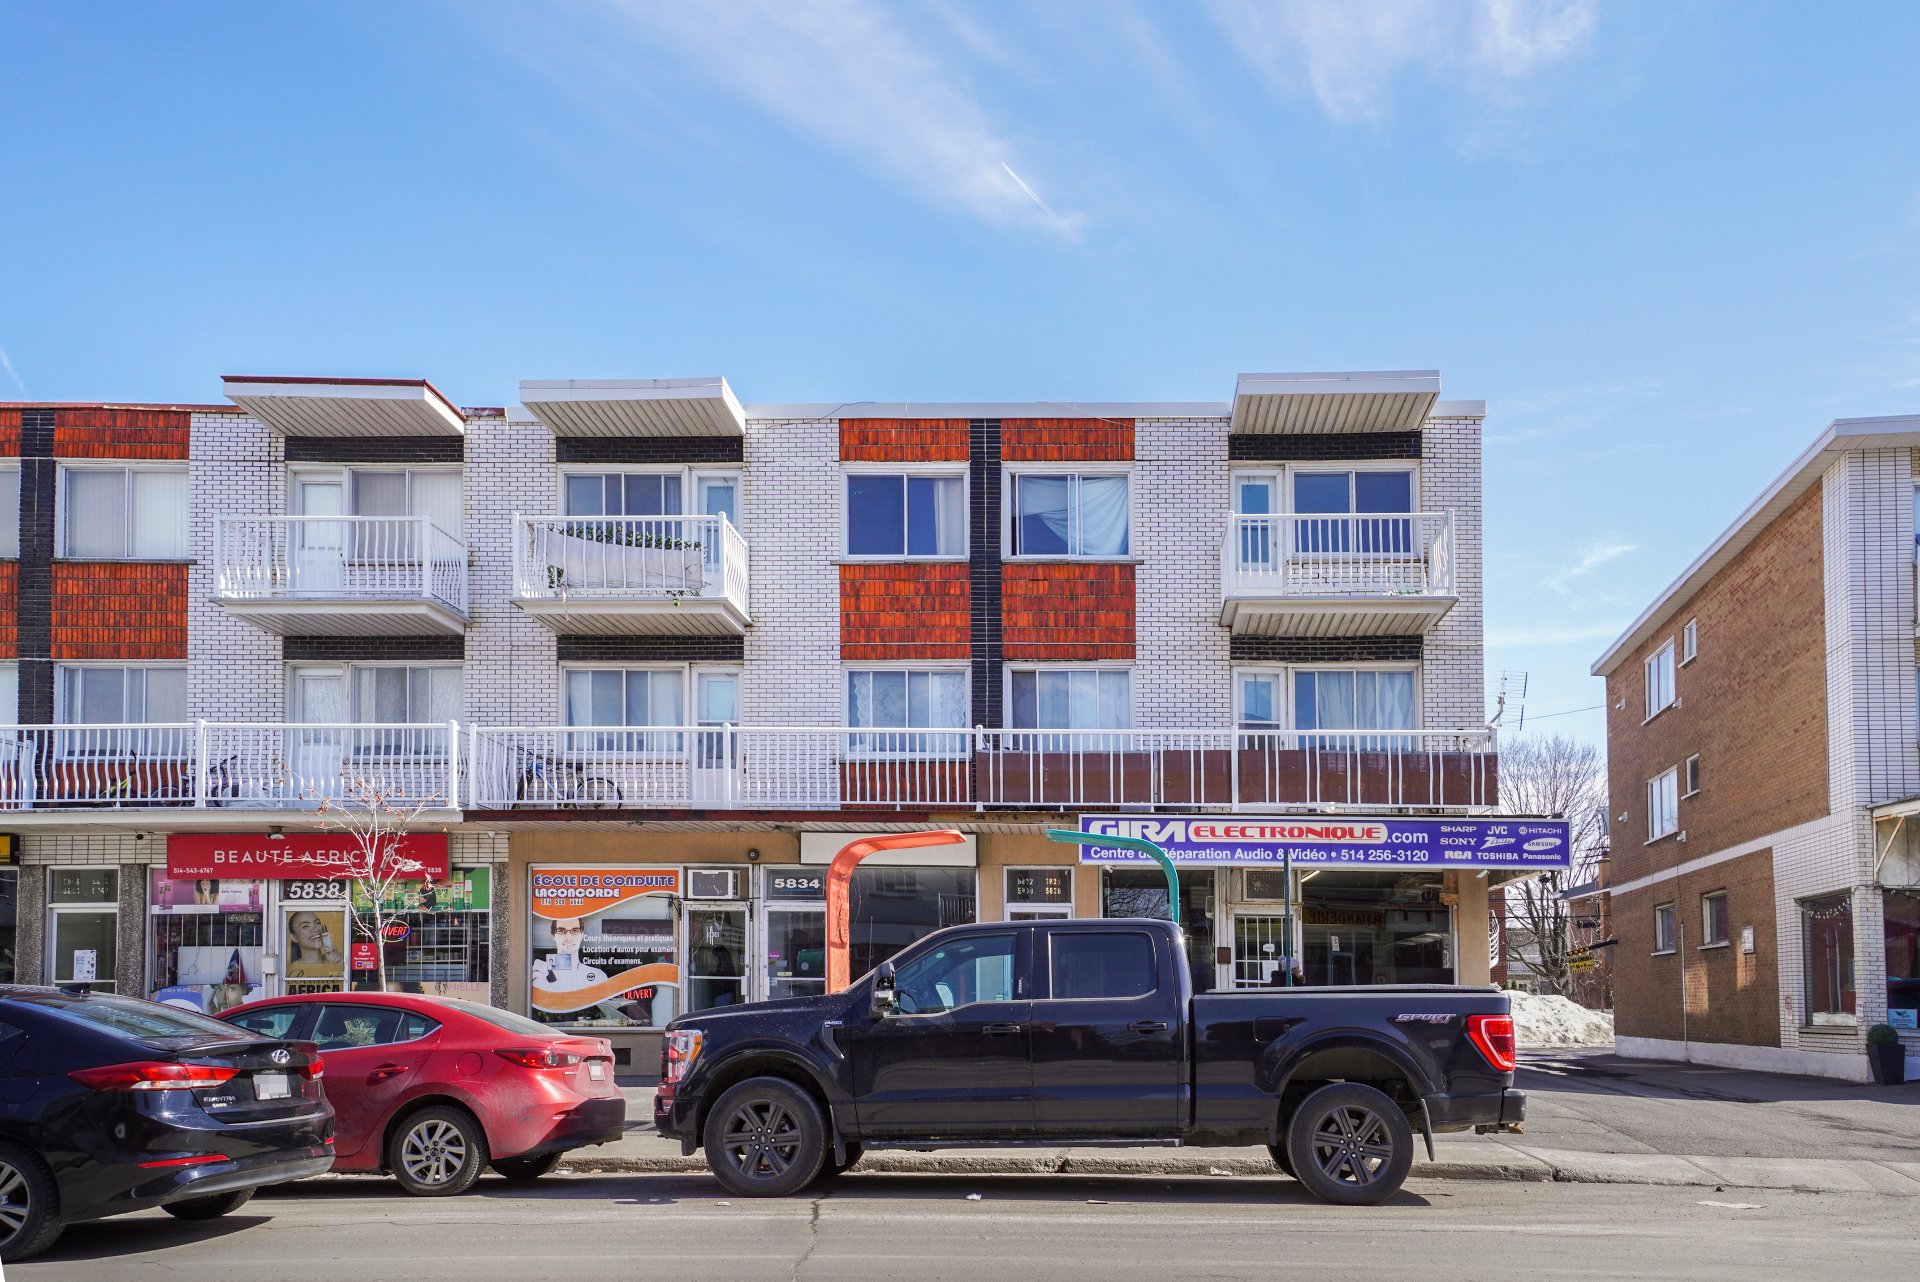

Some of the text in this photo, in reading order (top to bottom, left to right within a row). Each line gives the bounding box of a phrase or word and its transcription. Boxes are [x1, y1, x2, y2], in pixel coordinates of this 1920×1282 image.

[1089, 821, 1428, 843] GIRA ELECTRONIQUE .com
[1487, 826, 1507, 835] JVC
[214, 846, 293, 863] BEAUTÉ
[1091, 847, 1134, 859] Centre
[1235, 848, 1272, 860] Audio
[1277, 849, 1285, 860] &
[1290, 848, 1326, 860] Vidéo
[1341, 850, 1364, 861] 514
[1368, 850, 1428, 861] 256-3120
[1445, 851, 1472, 859] RCA
[1477, 852, 1519, 860] TOSHIBA
[533, 873, 676, 887] ÉCOLE DE CONDUITE
[774, 878, 820, 889] 5834
[289, 882, 340, 899] 5838
[535, 888, 620, 898] LACONCORDE
[603, 934, 635, 943] théoriques
[647, 935, 673, 944] pratiques
[583, 945, 609, 953] Location
[635, 947, 650, 955] pour
[583, 957, 642, 965] Circuits d'examens.
[288, 984, 340, 996] AFRICA
[448, 983, 482, 992] MIELLE
[624, 989, 653, 1000] OUVERT
[1395, 1013, 1456, 1022] SPORT
